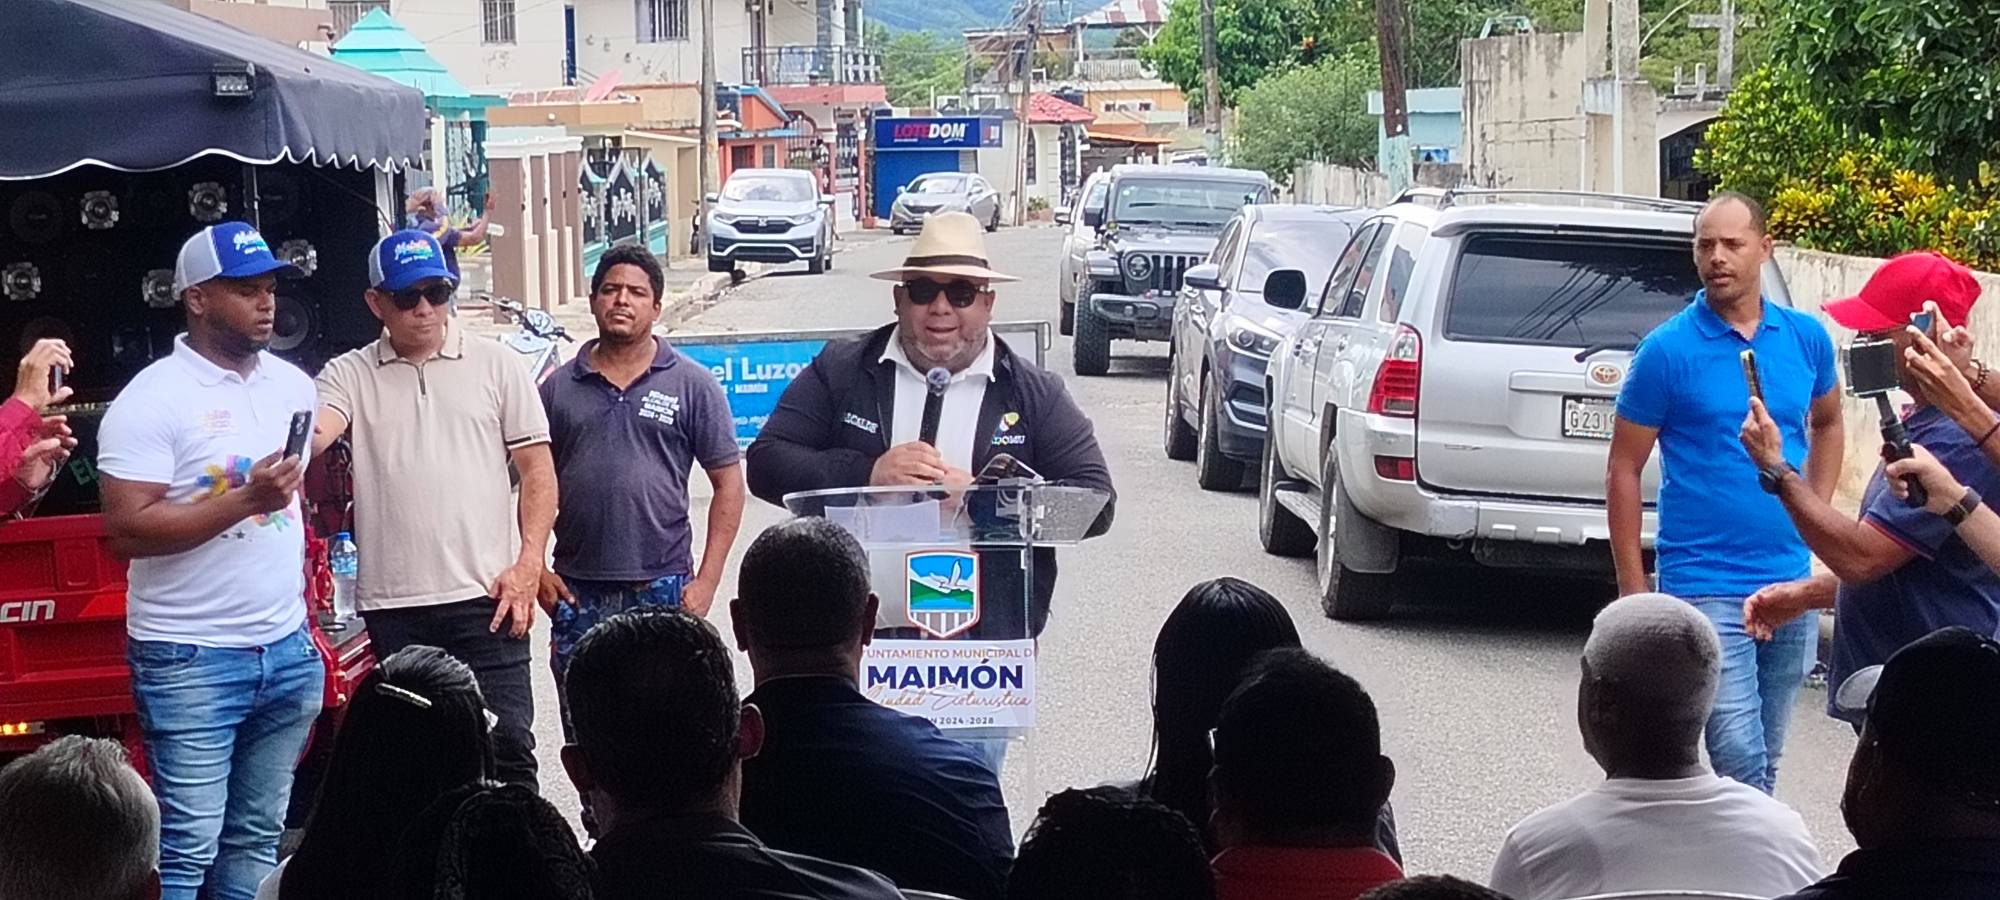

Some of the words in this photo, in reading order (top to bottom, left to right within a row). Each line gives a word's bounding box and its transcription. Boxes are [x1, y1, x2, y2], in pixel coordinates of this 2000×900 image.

[894, 123, 966, 139] LOTEDOM
[711, 357, 732, 381] el
[864, 649, 949, 659] UNTAMIENTO
[952, 648, 1021, 658] MUNICIPAL
[1023, 648, 1036, 658] D
[867, 658, 1023, 690] MAIMÓN
